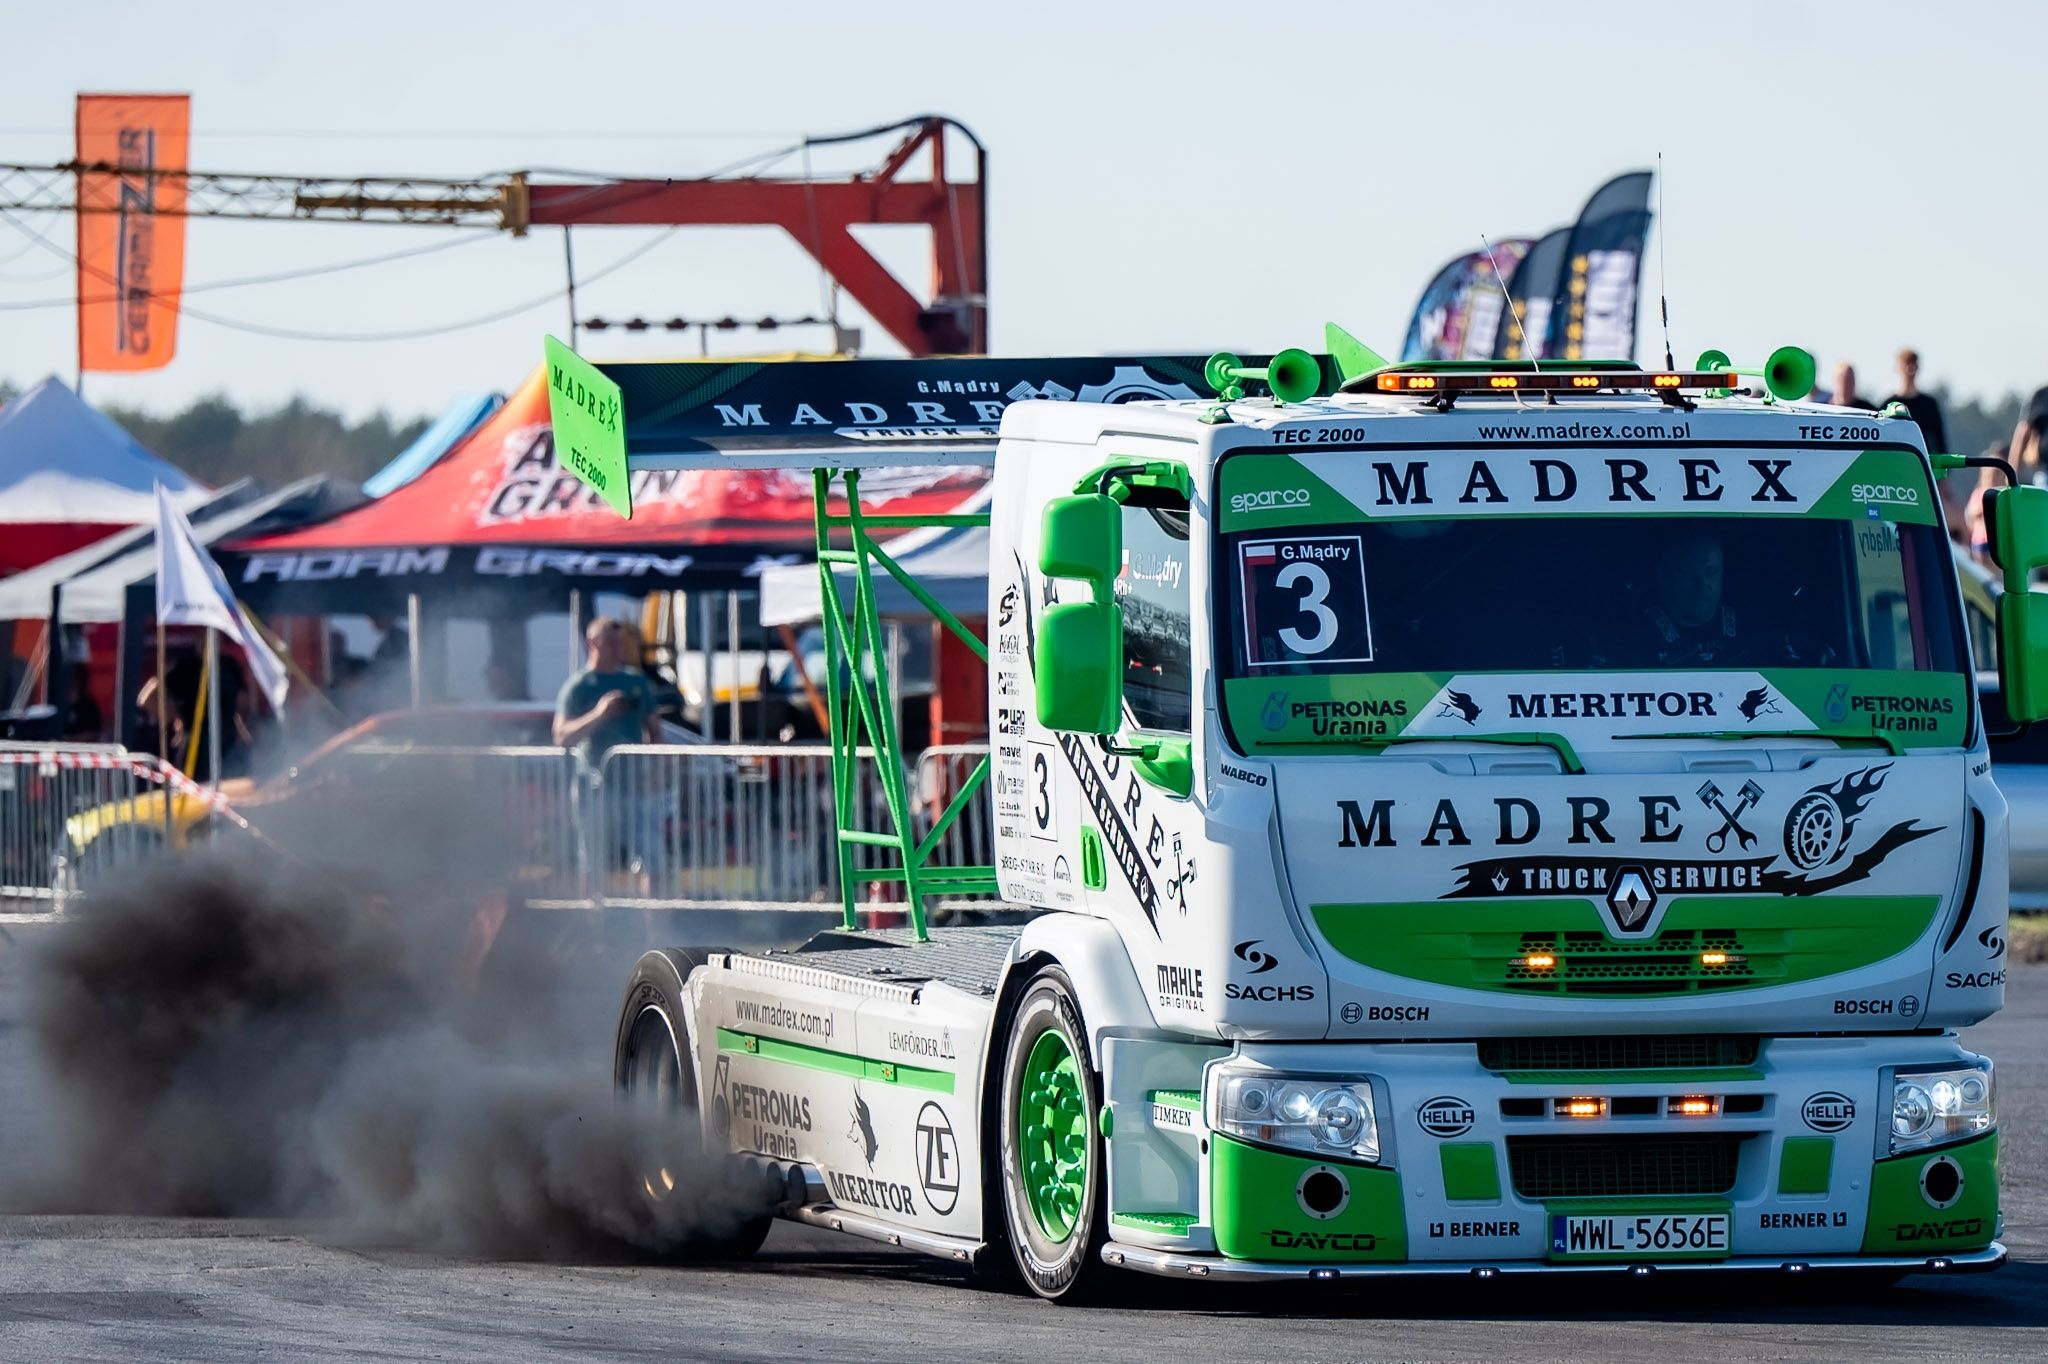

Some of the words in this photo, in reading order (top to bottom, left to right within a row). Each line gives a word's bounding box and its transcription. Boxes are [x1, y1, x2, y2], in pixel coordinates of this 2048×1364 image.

[917, 379, 1001, 395] G.Mądry
[854, 426, 962, 439] TRUCK
[1271, 429, 1312, 444] TEC
[1318, 427, 1365, 442] 2000
[1478, 421, 1691, 441] www.madrex.com.pl
[1799, 425, 1834, 440] TEC
[1839, 426, 1880, 441] 2000
[571, 446, 586, 474] TEC
[588, 461, 607, 491] 2000
[1371, 458, 1798, 506] MADREX
[1230, 488, 1311, 513] sparco
[1851, 483, 1920, 506] sparco
[1281, 543, 1351, 562] G.Mądry
[1275, 562, 1339, 655] 3
[1290, 699, 1408, 720] PETRONAS
[1507, 692, 1718, 719] MERITOR
[1851, 695, 1954, 715] PETRONAS
[1312, 717, 1387, 736] Urania
[1871, 713, 1938, 732] Urania
[1221, 763, 1267, 788] WABCO
[1034, 752, 1050, 831] 3
[1098, 797, 1141, 890] SERVICE
[1522, 868, 1608, 890] TRUCK
[1653, 865, 1762, 888] SERVICE
[1157, 964, 1203, 999] MAHLE
[1945, 968, 2007, 989] SACHS
[1225, 983, 1315, 1002] SACHS
[1159, 996, 1205, 1013] ORIGINAL
[1368, 1006, 1430, 1021] BOSCH
[1834, 1000, 1893, 1014] BOSCH
[735, 999, 834, 1044] www.madrex.com.pl
[888, 1030, 939, 1058] LEMFÖRDER
[732, 1081, 812, 1133] PETRONAS
[1153, 1104, 1192, 1127] TIMKEN
[1422, 1109, 1475, 1125] HELLA
[1806, 1105, 1856, 1119] HELLA
[753, 1123, 798, 1160] Urania
[828, 1170, 918, 1216] MERITOR
[1450, 1221, 1520, 1238] BERNER
[1760, 1211, 1828, 1229] BERNER
[1895, 1219, 1984, 1242] DAYCO
[1269, 1228, 1379, 1252] DAYCO
[1554, 1238, 1566, 1249] PL
[1569, 1218, 1626, 1251] WWL
[1635, 1215, 1725, 1250] 5656E
